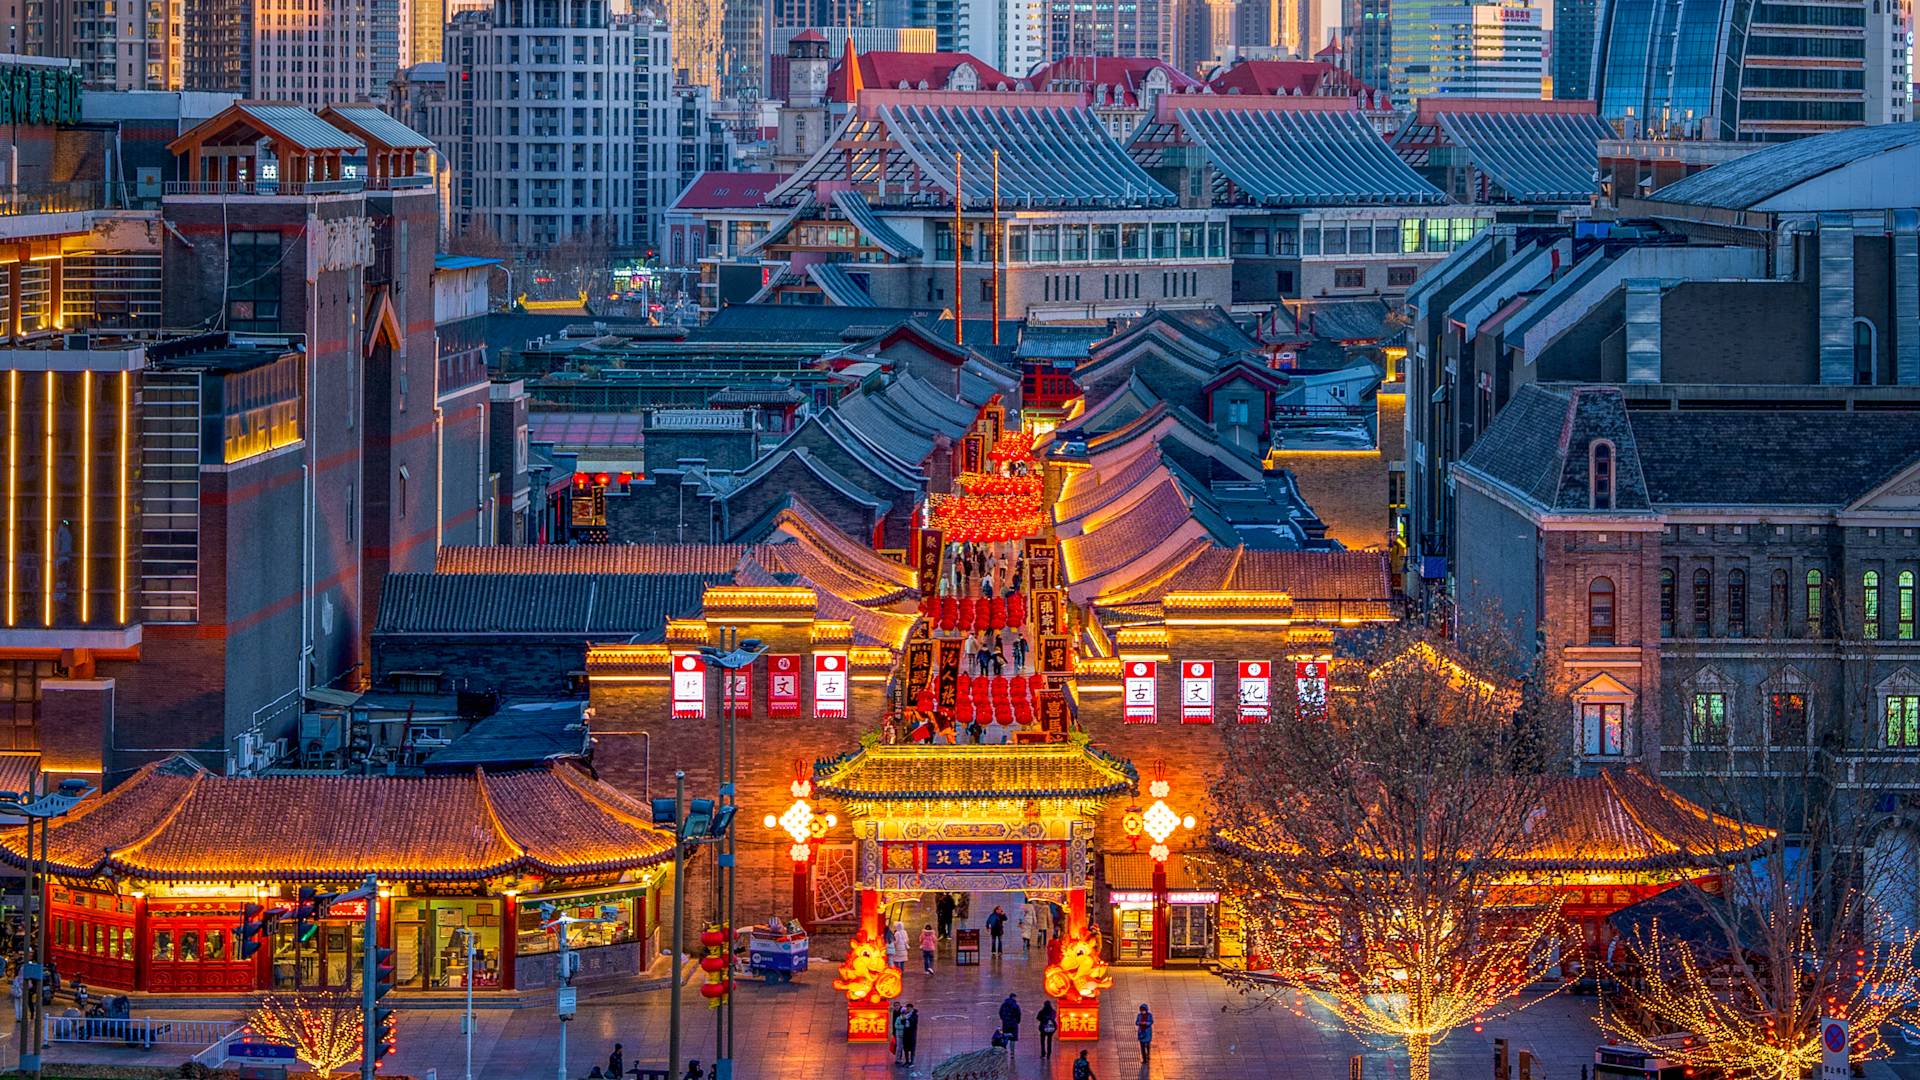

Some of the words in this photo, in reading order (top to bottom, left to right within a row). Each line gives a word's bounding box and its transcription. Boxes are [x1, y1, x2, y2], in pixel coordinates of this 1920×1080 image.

[776, 677, 792, 695] 文
[823, 677, 840, 694] 古
[1132, 684, 1148, 700] 古
[1190, 684, 1206, 701] 文
[1246, 685, 1263, 700] 化
